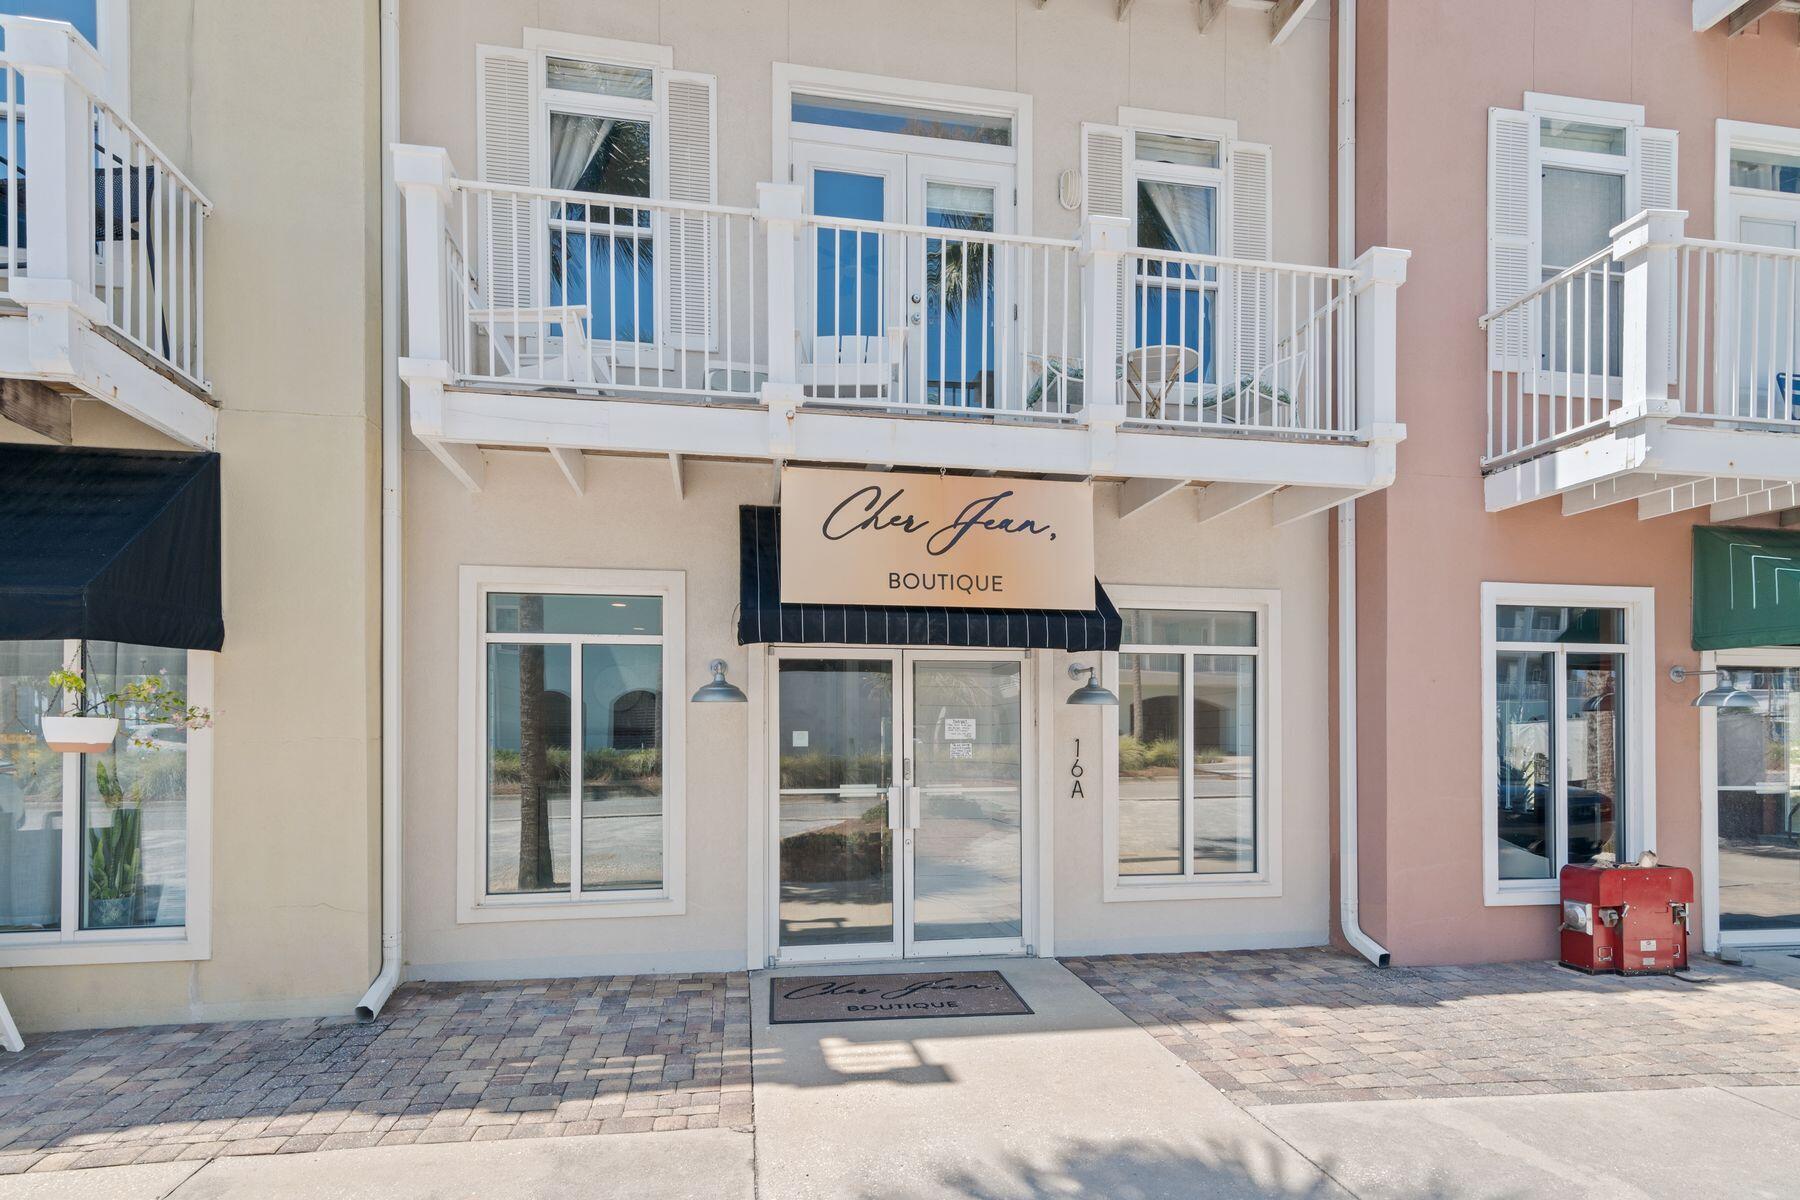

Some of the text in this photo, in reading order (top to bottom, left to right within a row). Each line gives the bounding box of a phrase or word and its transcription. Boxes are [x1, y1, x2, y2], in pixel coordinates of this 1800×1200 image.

[822, 486, 929, 540] Cher
[888, 572, 1004, 594] BOUTIQUE
[1071, 738, 1084, 799] 16A
[784, 981, 880, 1000] Cher
[846, 1000, 959, 1012] BOUTIQUE
